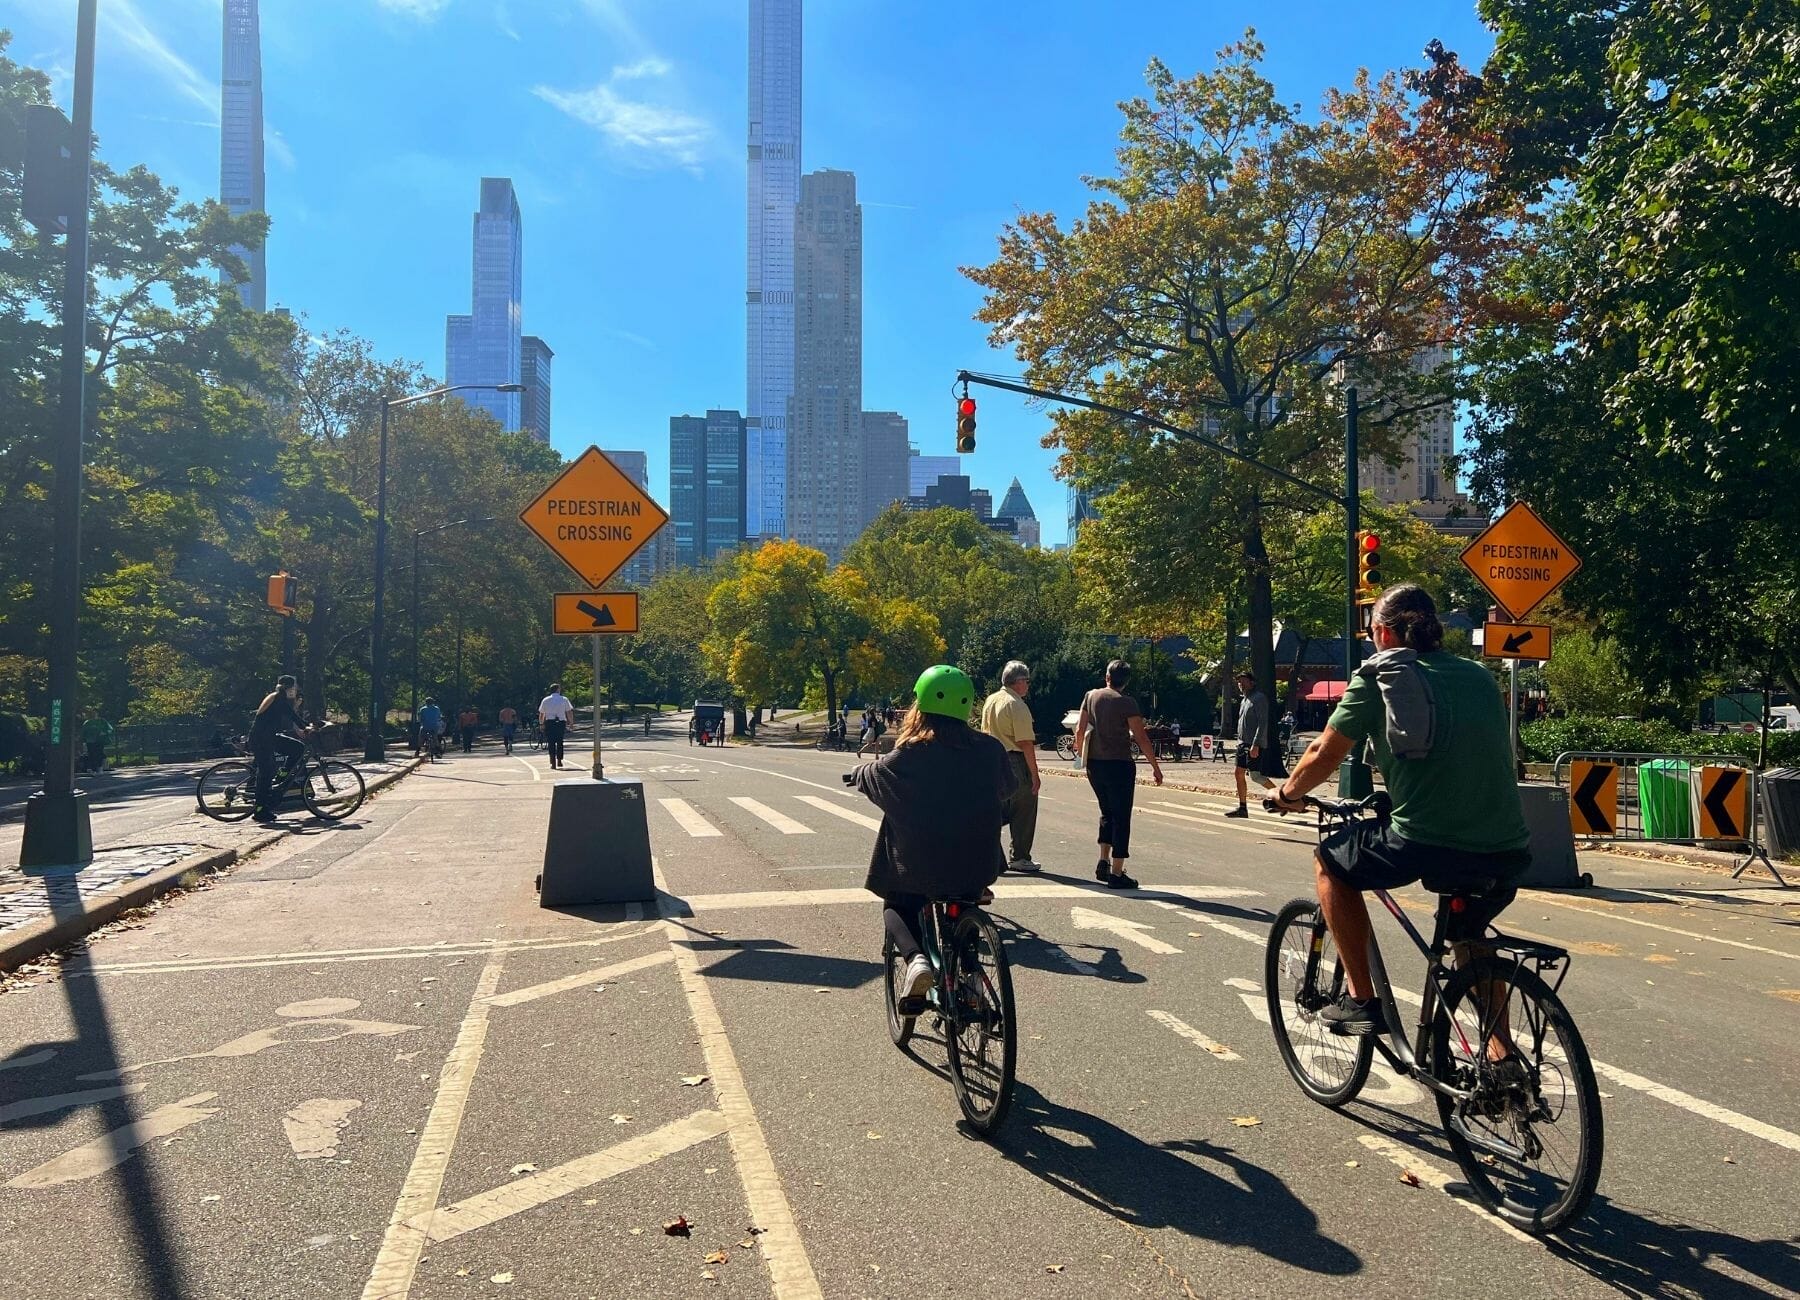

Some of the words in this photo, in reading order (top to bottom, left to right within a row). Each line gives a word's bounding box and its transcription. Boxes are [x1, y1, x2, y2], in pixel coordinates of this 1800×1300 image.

[547, 500, 641, 517] PEDESTRIAN
[557, 525, 632, 541] CROSSING
[1482, 544, 1559, 561] PEDESTRIAN
[1489, 566, 1550, 581] CROSSING
